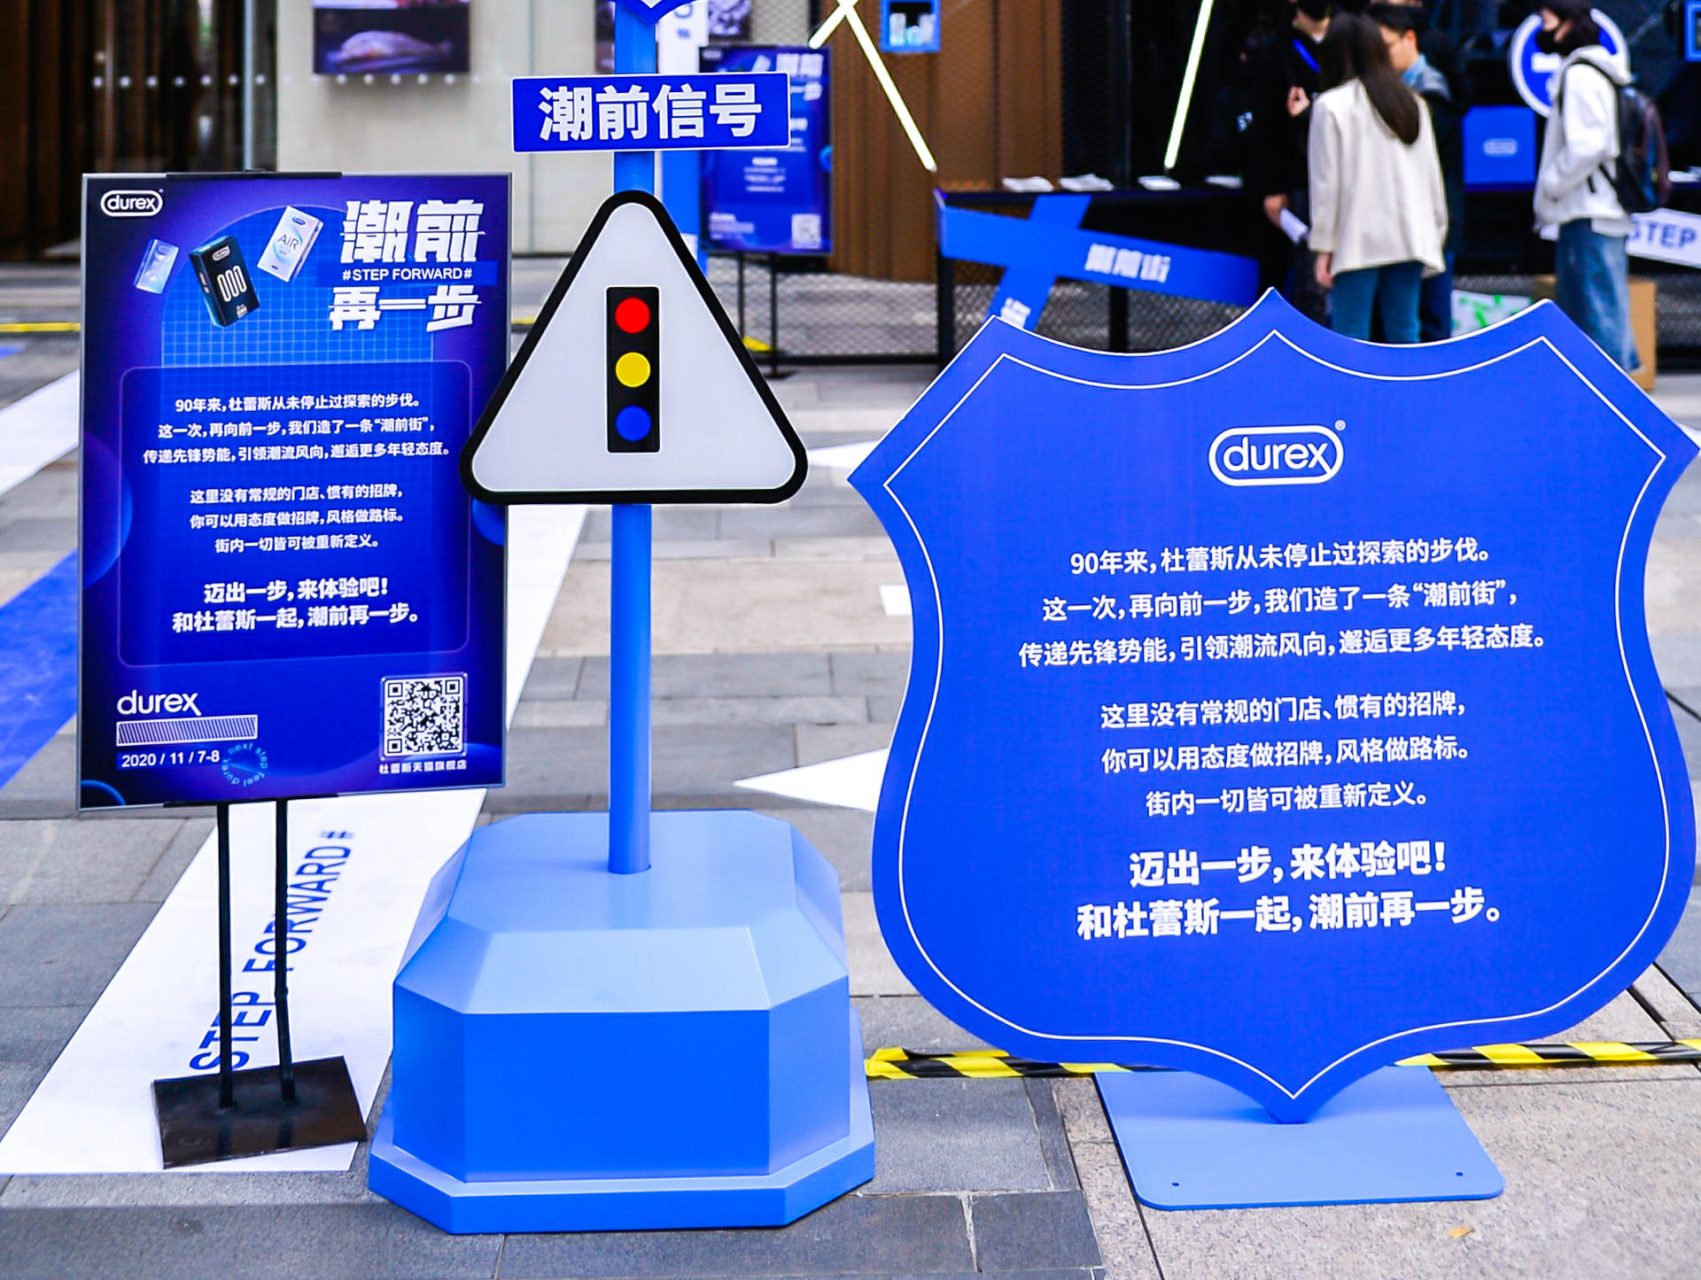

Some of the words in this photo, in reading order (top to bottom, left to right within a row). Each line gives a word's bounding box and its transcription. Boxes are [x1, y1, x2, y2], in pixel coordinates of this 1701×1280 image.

[538, 83, 763, 142] 潮前信号
[106, 194, 157, 212] durex
[339, 199, 487, 264] 潮前
[342, 268, 389, 281] #STEP
[392, 267, 473, 281] FORWARD#
[328, 284, 482, 332] 再一步
[1223, 437, 1333, 473] durex
[116, 690, 202, 716] durex
[121, 753, 156, 768] 2020
[170, 752, 184, 766] 11
[197, 749, 221, 765] 7-8
[1146, 781, 1427, 817] 街内一切皆可被重新定义。
[1129, 841, 1446, 888] 迈出一步，来体验吧！
[1077, 886, 1501, 941] 和杜蕾斯一起，潮前再一步。
